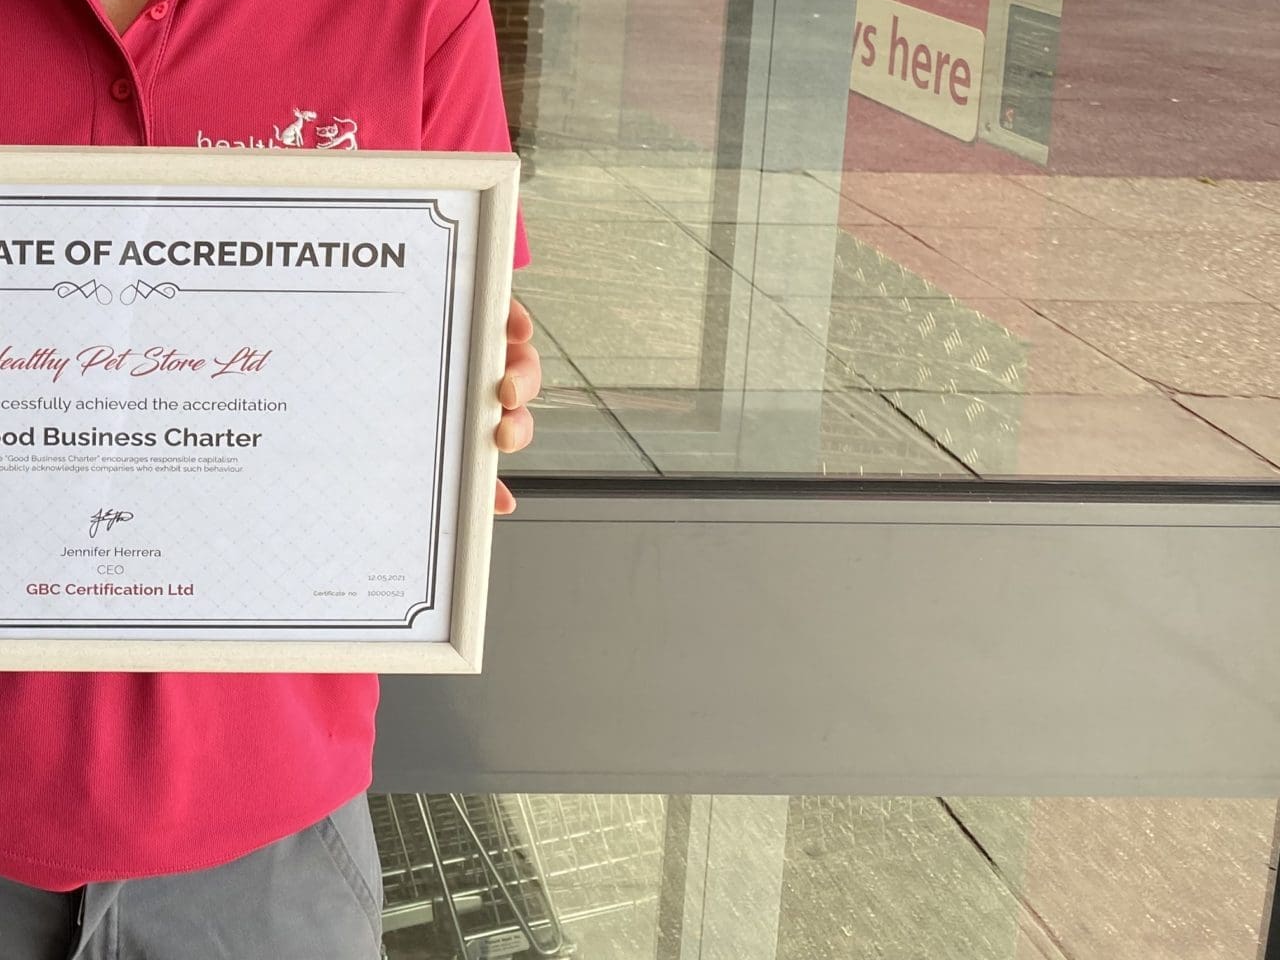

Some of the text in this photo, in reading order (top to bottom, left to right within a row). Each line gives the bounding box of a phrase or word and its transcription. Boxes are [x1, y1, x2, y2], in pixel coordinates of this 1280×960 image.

[887, 14, 972, 107] here
[65, 240, 113, 266] OF
[118, 240, 406, 268] ACCREDITATION
[76, 345, 133, 376] Pet
[129, 346, 206, 377] Store
[210, 346, 273, 379] Ltd
[75, 397, 148, 411] achieved
[153, 398, 179, 411] the
[182, 398, 287, 412] accreditation
[43, 426, 157, 447] Business
[164, 427, 263, 448] Charter
[31, 454, 67, 463] Business
[101, 456, 148, 465] encourages
[150, 455, 195, 465] responsible
[197, 455, 238, 464] capitalism
[0, 463, 30, 474] publicly
[31, 464, 89, 474] acknowledges
[90, 465, 134, 474] companies
[135, 465, 153, 473] who
[154, 464, 181, 473] exhibit
[183, 465, 202, 473] such
[60, 547, 162, 558] Jennifer Herrera
[96, 564, 125, 576] CEO
[26, 583, 194, 596] GBC Certification Ltd
[312, 590, 346, 598] Certificate
